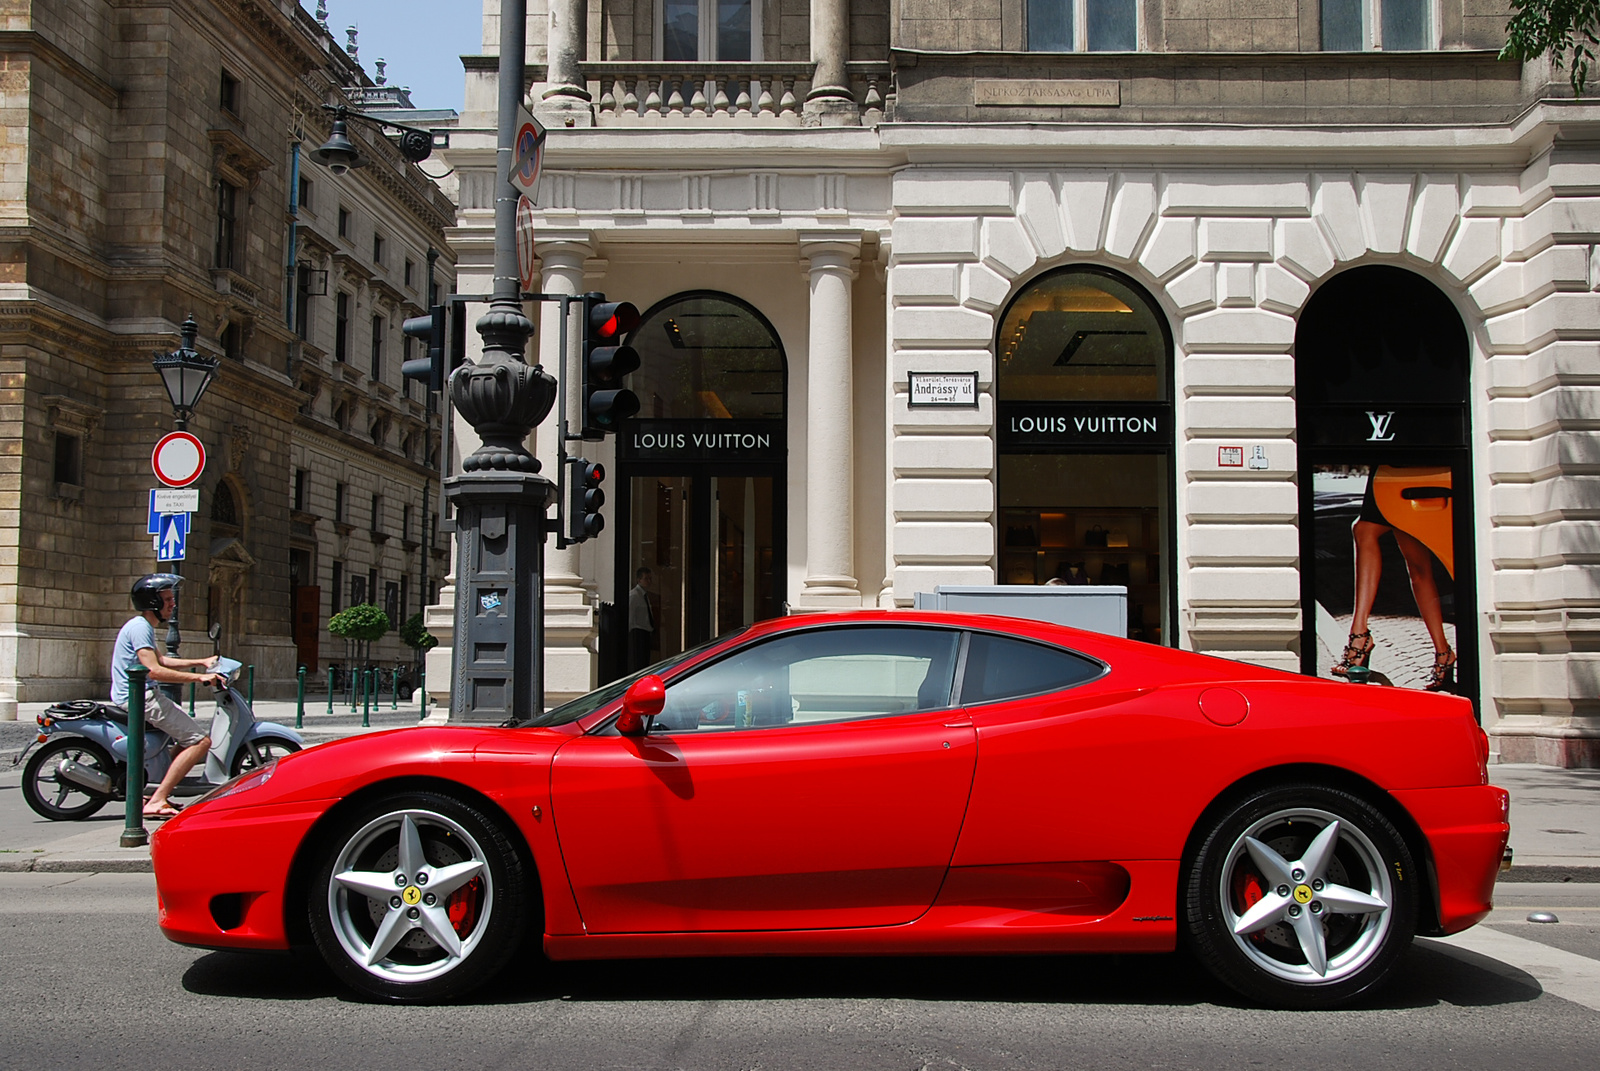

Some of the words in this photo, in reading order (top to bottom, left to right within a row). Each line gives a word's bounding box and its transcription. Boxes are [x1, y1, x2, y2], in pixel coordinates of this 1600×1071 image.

[914, 383, 958, 397] Andrássy
[1011, 417, 1067, 433] LOUIS
[1073, 417, 1157, 433] VUITTON
[1365, 411, 1395, 441] LV
[634, 433, 686, 448] LOUIS
[692, 433, 770, 448] VUITTON
